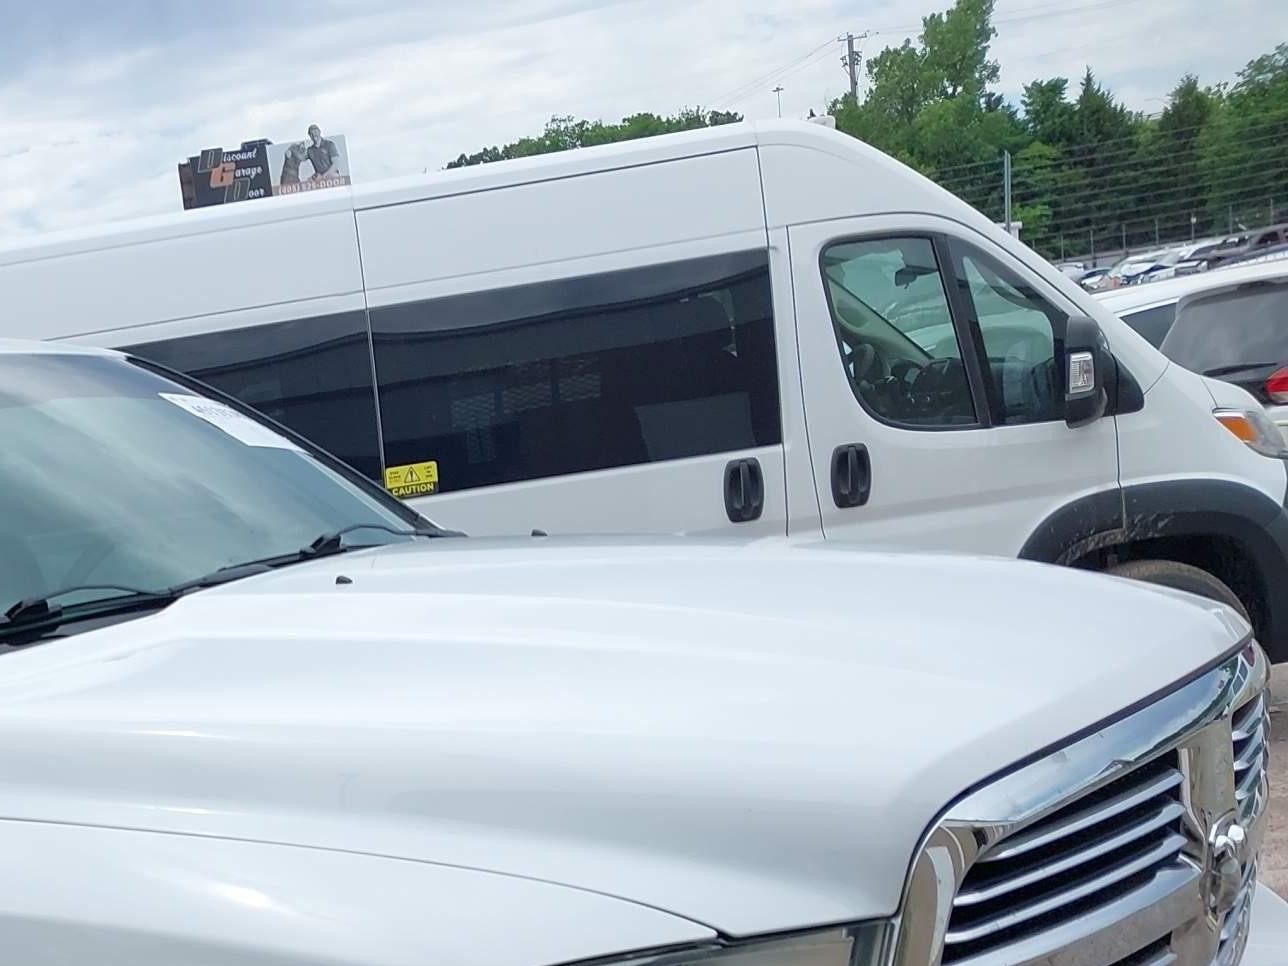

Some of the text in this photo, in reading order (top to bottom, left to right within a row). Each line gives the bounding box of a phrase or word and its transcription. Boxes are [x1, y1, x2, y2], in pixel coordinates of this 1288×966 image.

[198, 148, 257, 173] Discount
[210, 162, 263, 188] Garage
[224, 177, 265, 203] Door
[392, 482, 434, 496] CAUTION
